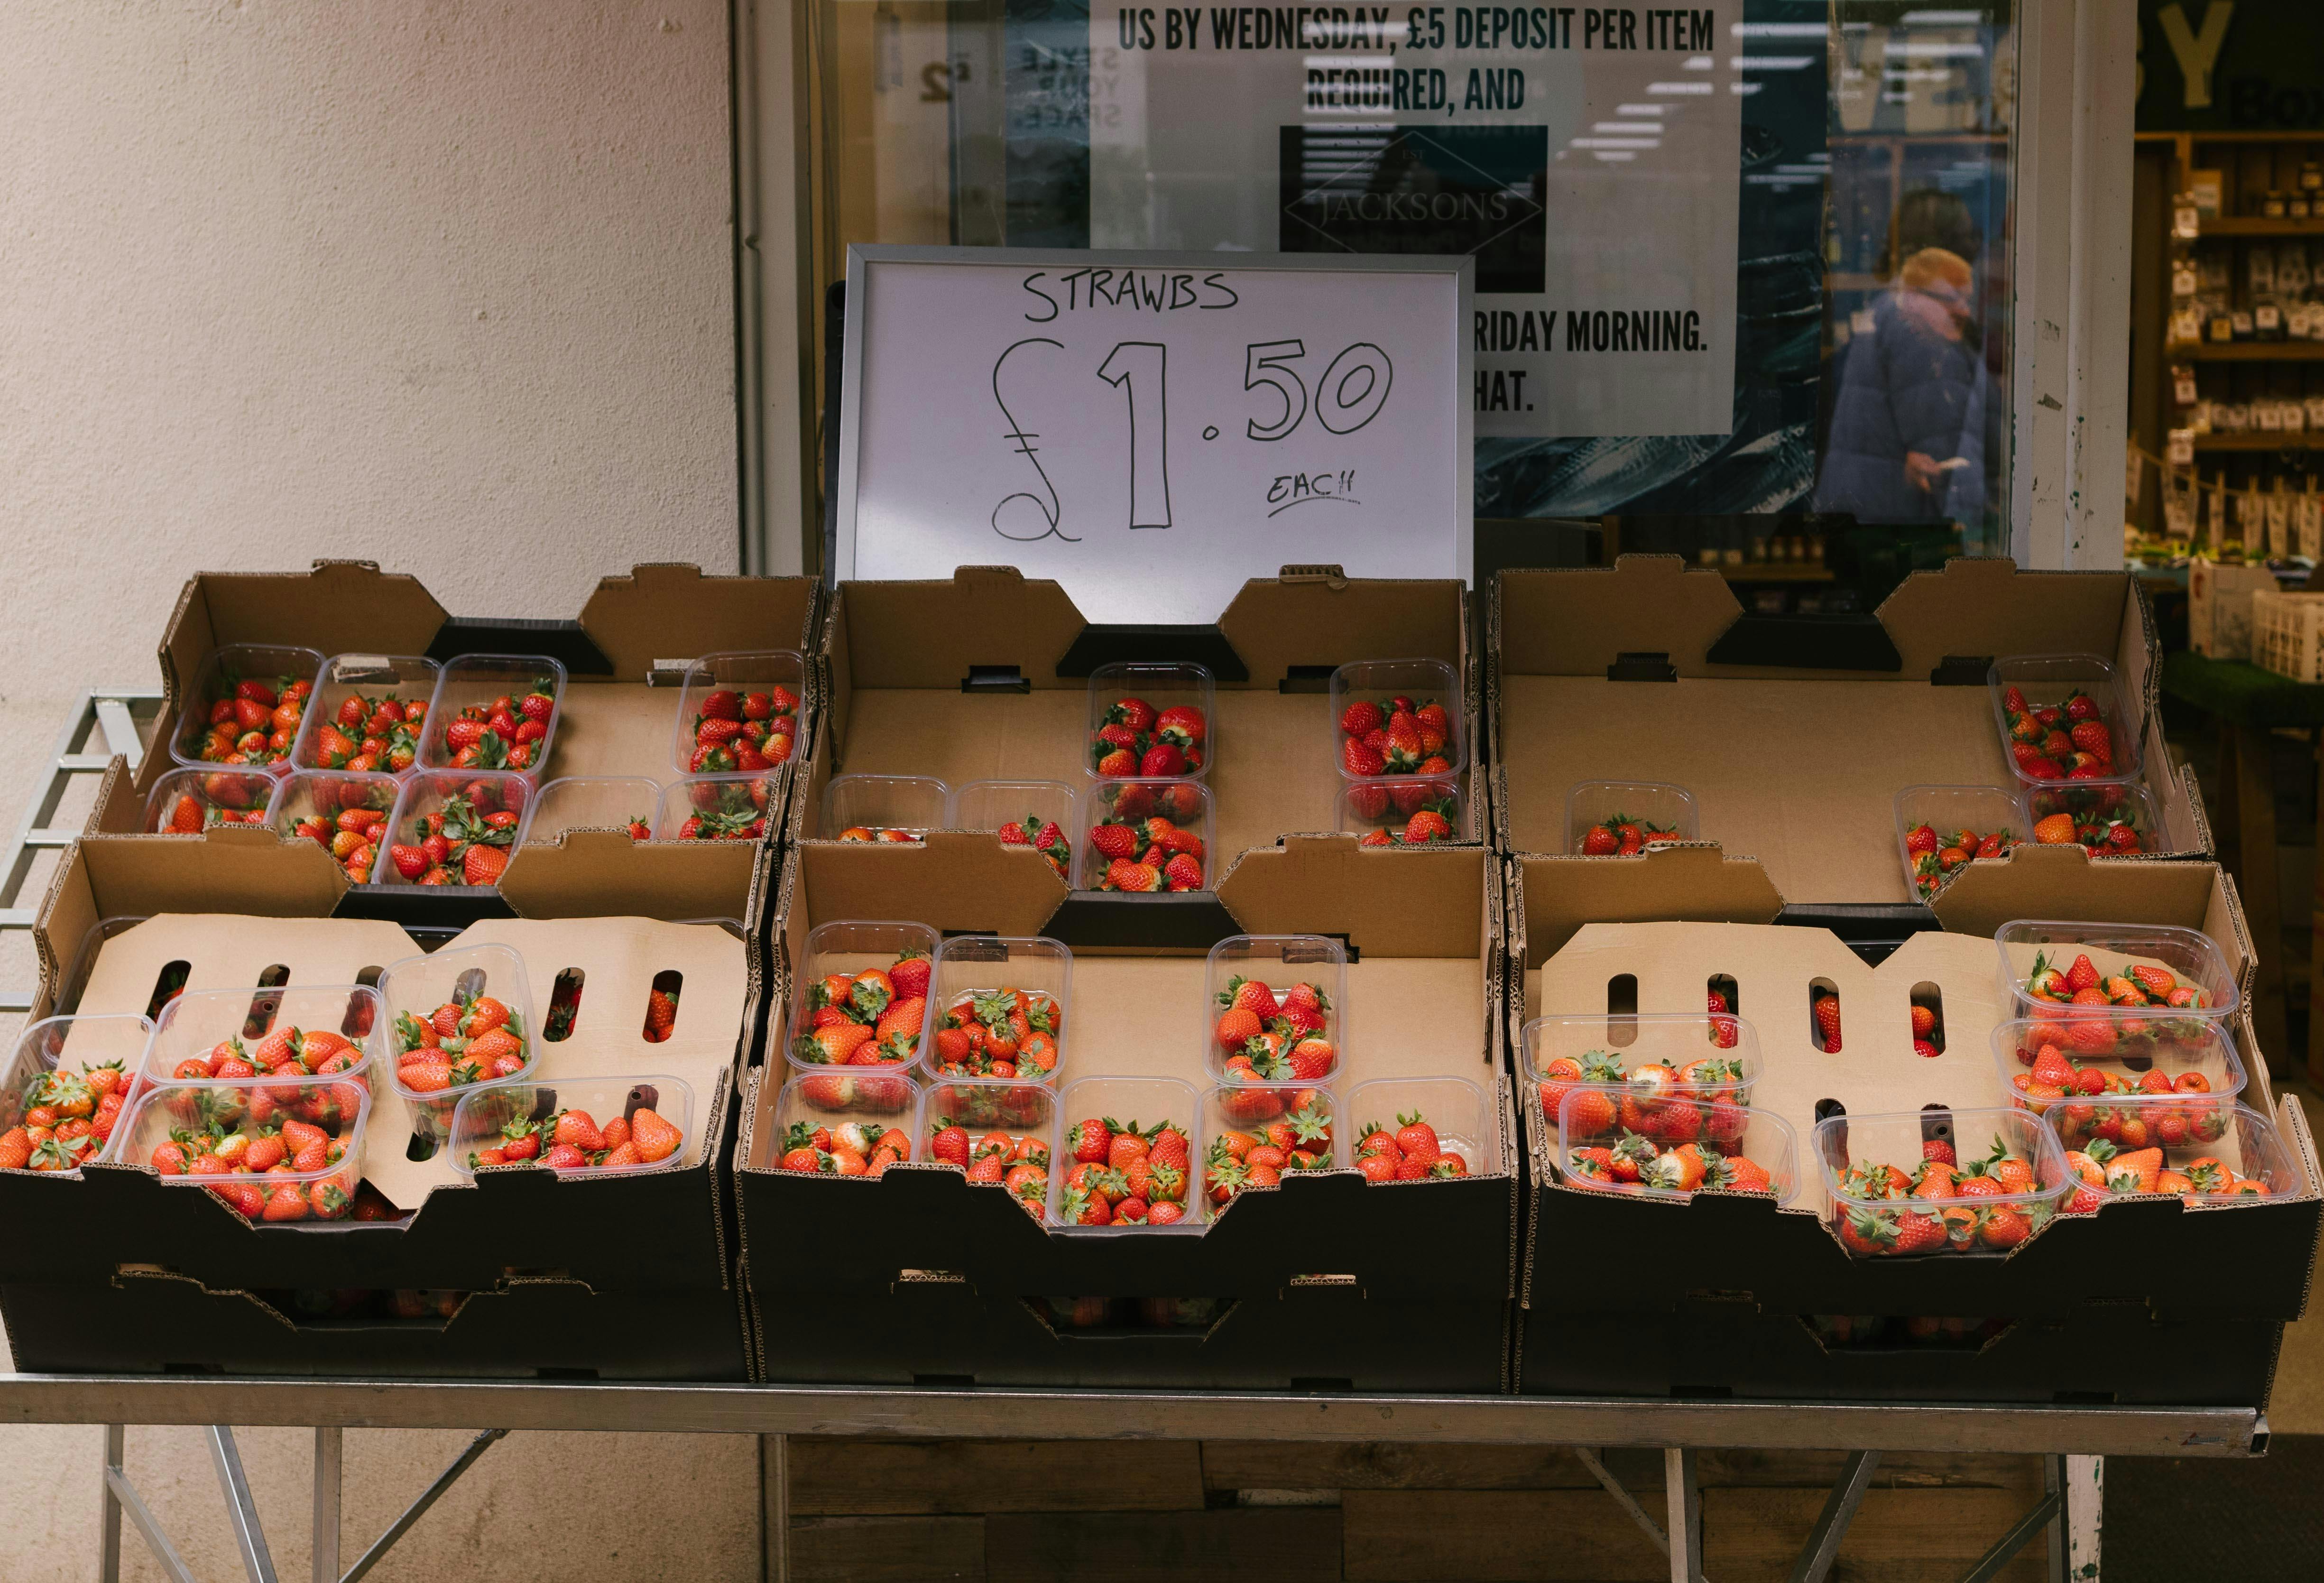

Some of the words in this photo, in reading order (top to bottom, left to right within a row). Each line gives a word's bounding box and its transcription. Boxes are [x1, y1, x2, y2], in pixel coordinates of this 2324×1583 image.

[1119, 8, 1155, 50] US
[1165, 8, 1201, 50] BY
[1211, 7, 1397, 56] WEDNESDAY,
[1406, 7, 1445, 49] £5
[1456, 7, 1575, 49] DEPOSIT
[1585, 9, 1636, 50] PER
[1646, 9, 1714, 51] ITEM
[2135, 0, 2234, 108] Y
[1308, 68, 1455, 117] REQUIRED,
[1464, 68, 1524, 110] AND
[1319, 193, 1508, 228] JACKSONS
[1024, 268, 1238, 322] STRAWBS
[1474, 311, 1557, 351] RIDAY
[1567, 310, 1707, 352] MORNING.
[1474, 370, 1533, 411] HAT.
[992, 338, 1393, 541] £1.50
[1267, 470, 1355, 503] EACH
